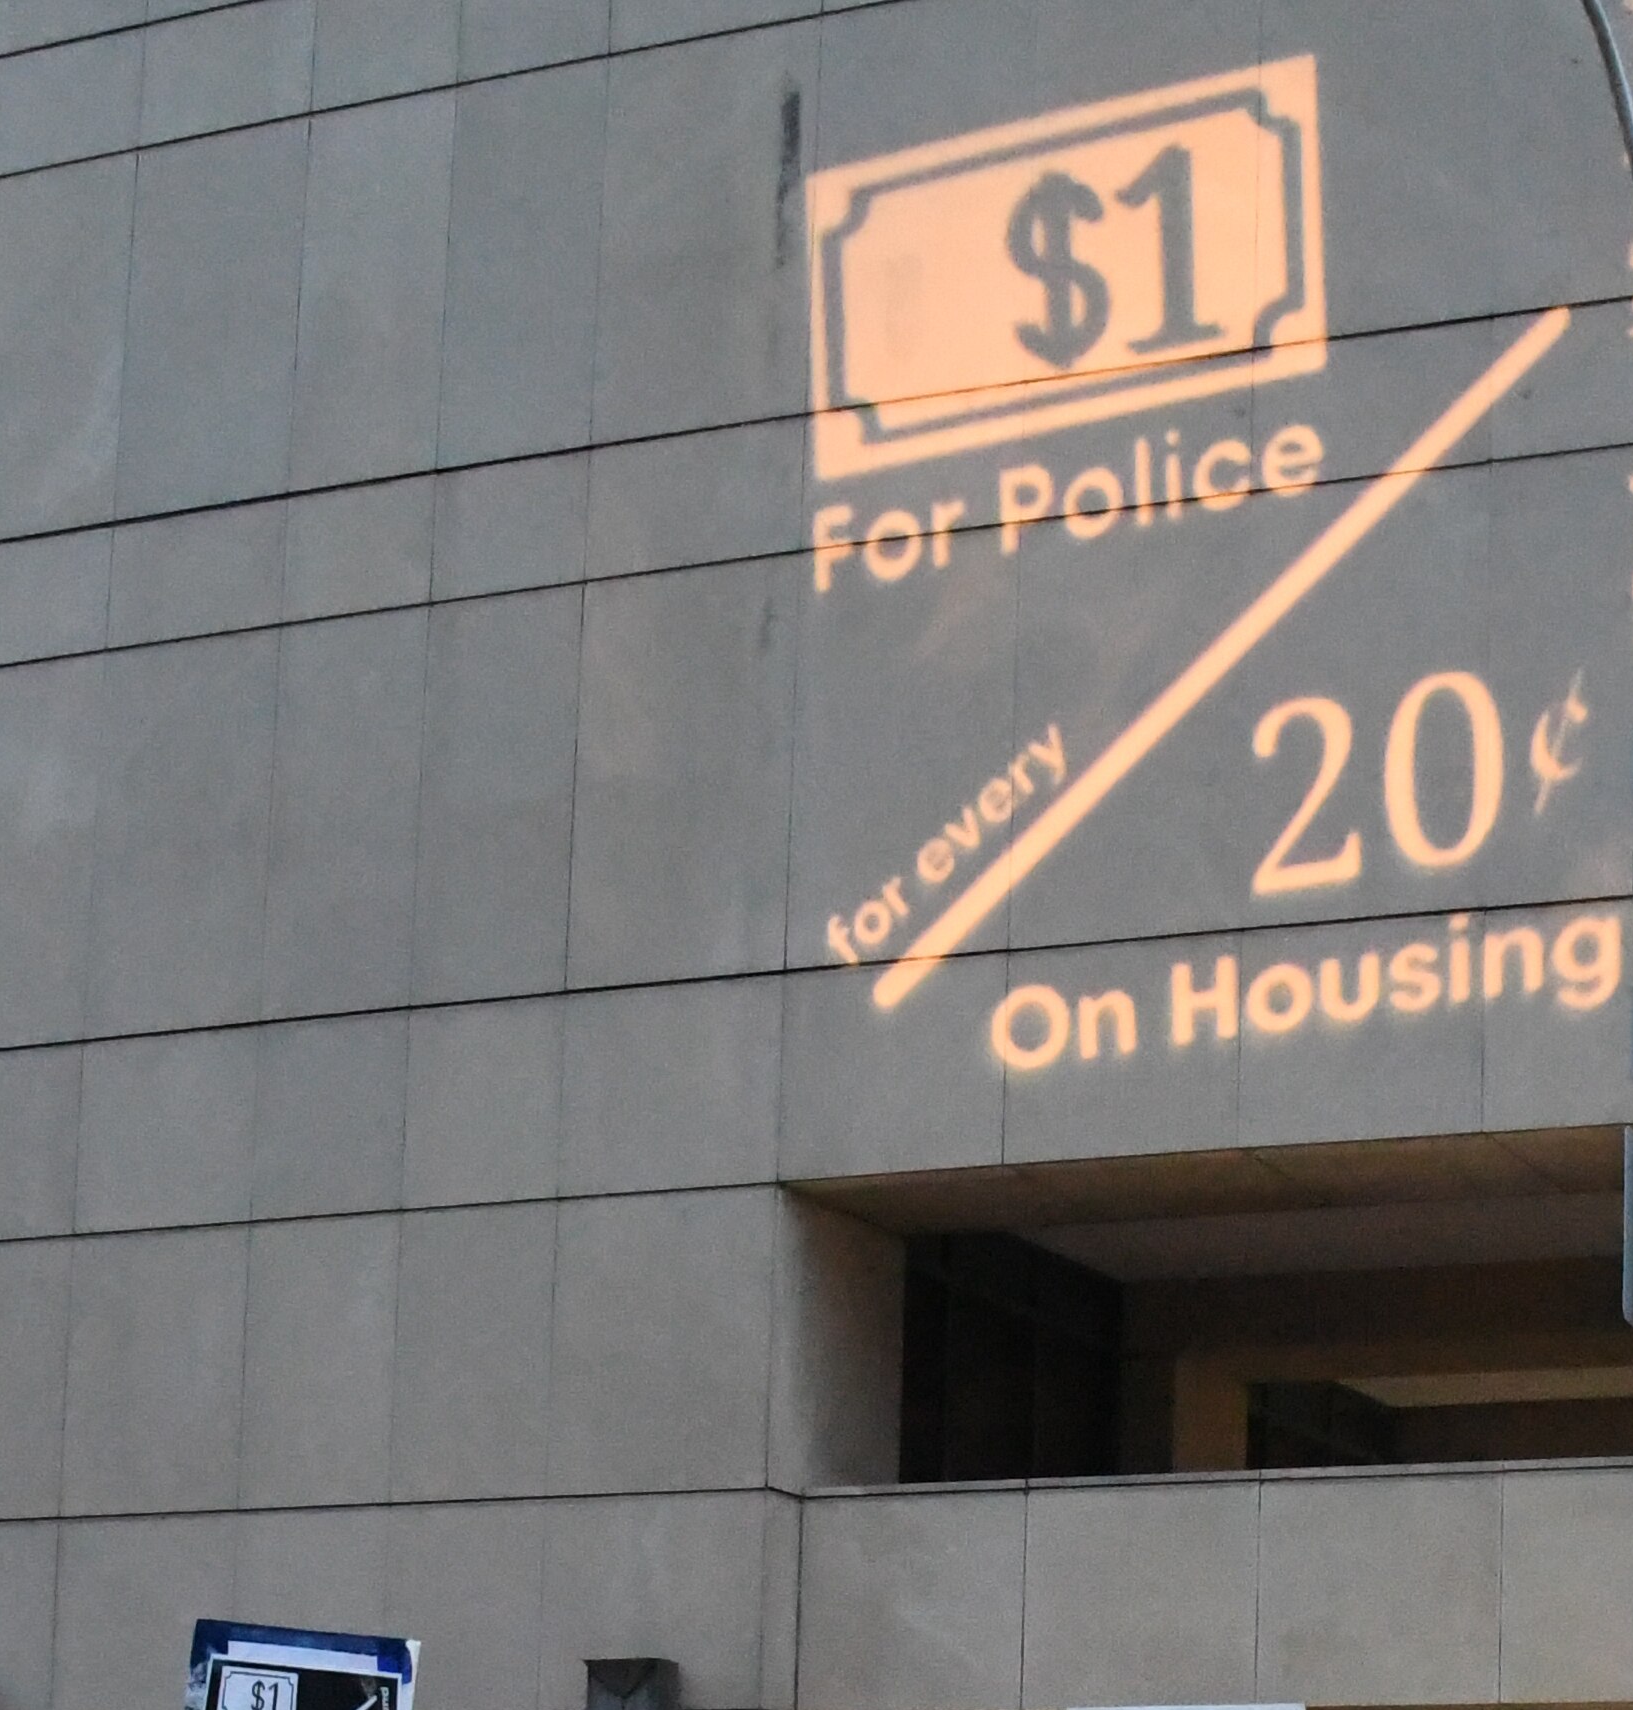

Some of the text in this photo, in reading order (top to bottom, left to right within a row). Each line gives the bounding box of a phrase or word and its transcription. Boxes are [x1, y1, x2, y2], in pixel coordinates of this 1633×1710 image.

[1005, 142, 1230, 370] $1
[811, 422, 1325, 594] For Police
[825, 722, 1070, 966] for every
[990, 914, 1623, 1070] On Housing
